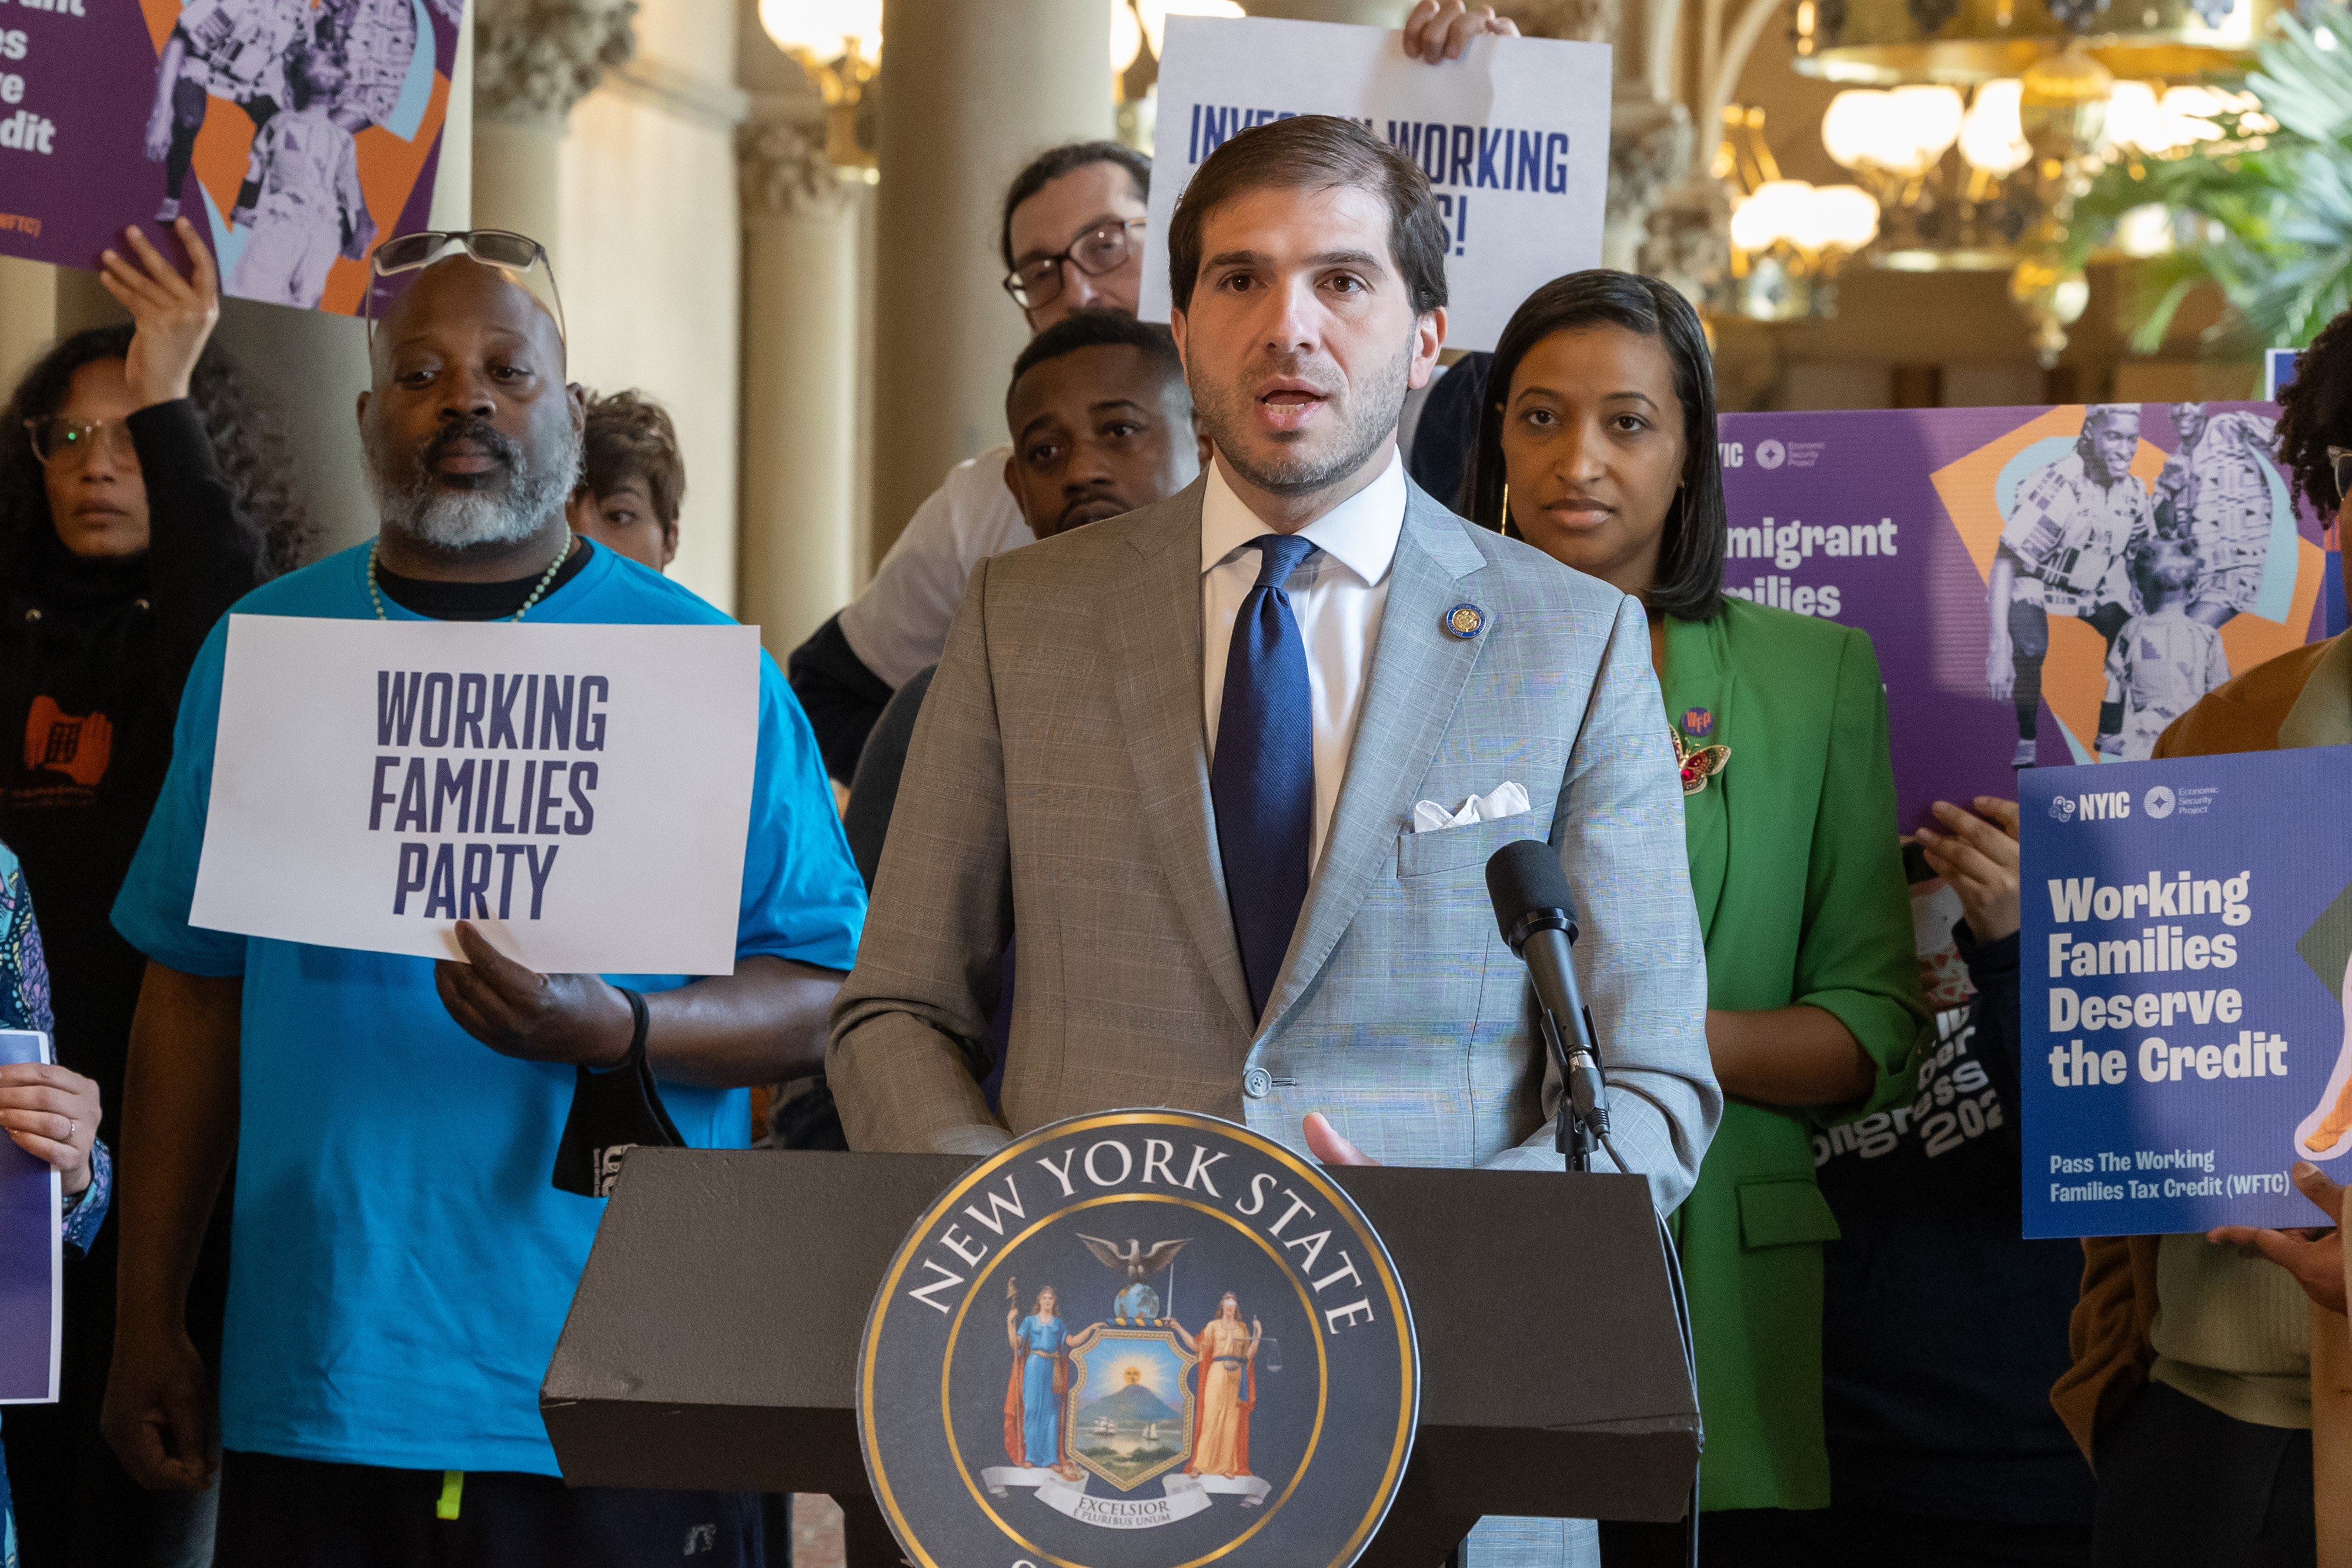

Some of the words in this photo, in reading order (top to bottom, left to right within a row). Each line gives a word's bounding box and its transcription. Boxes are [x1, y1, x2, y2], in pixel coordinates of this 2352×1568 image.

[1388, 121, 1569, 195] WORKING
[1727, 517, 1898, 570] migrant
[1721, 575, 1841, 617] ilies
[377, 671, 609, 751] WORKING
[1686, 712, 1711, 733] WFP
[369, 756, 599, 835] FAMILIES
[2079, 791, 2130, 821] NYIC
[2178, 787, 2219, 795] Economic
[2178, 796, 2213, 805] Security
[2179, 805, 2208, 815] Project
[393, 842, 559, 920] PARTY
[2048, 871, 2251, 926] Working
[2049, 925, 2237, 977] Families
[2049, 988, 2243, 1032] Deserve
[2049, 1039, 2127, 1087] the
[2139, 1031, 2288, 1083] Credit
[1813, 1060, 1989, 1168] ongress
[2050, 1155, 2094, 1174] Pass
[2098, 1153, 2132, 1171] The
[2135, 1149, 2215, 1173] Working
[2050, 1181, 2124, 1202] Families
[2128, 1180, 2160, 1199] Tax
[2164, 1177, 2223, 1198] Credit
[2227, 1171, 2290, 1199] (WFTC)
[908, 1175, 1027, 1315] NEW
[1036, 1138, 1231, 1198] YORK
[1235, 1172, 1375, 1335] STATE
[1078, 1497, 1170, 1516] EXCELSIOR
[1081, 1512, 1133, 1526] PLURIBUS
[1135, 1513, 1171, 1526] UNUM
